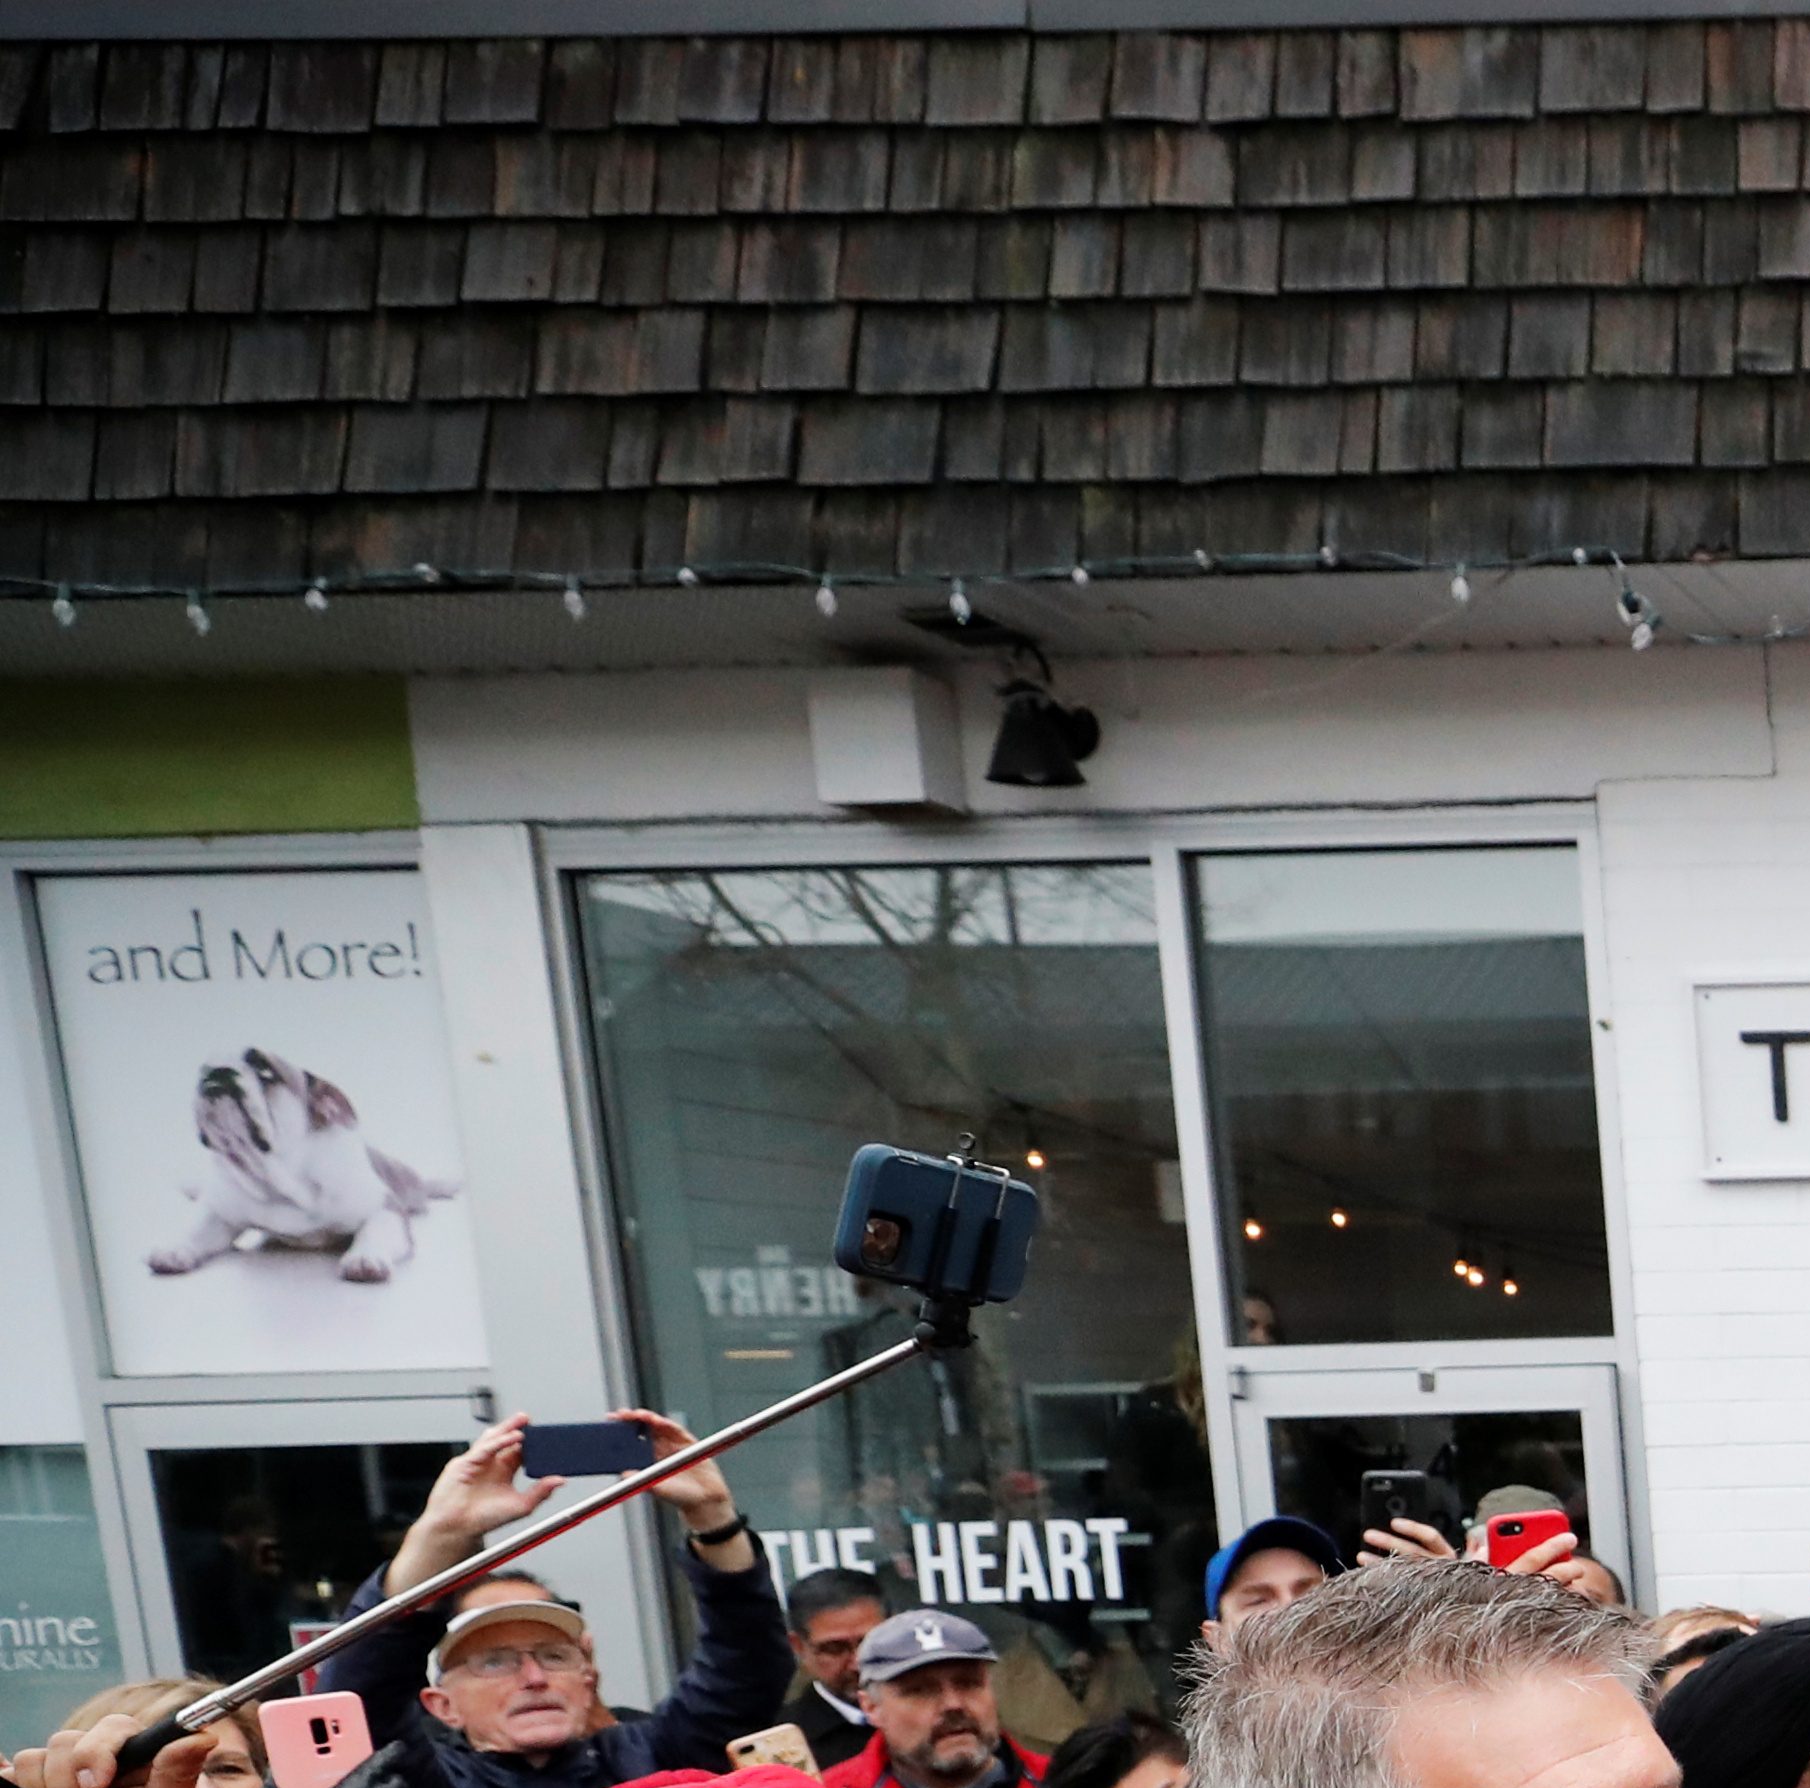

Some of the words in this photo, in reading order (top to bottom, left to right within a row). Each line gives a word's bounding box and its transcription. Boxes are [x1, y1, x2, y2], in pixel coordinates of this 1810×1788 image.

[86, 909, 212, 984] and
[232, 922, 423, 981] More!
[912, 1517, 1128, 1605] HEART
